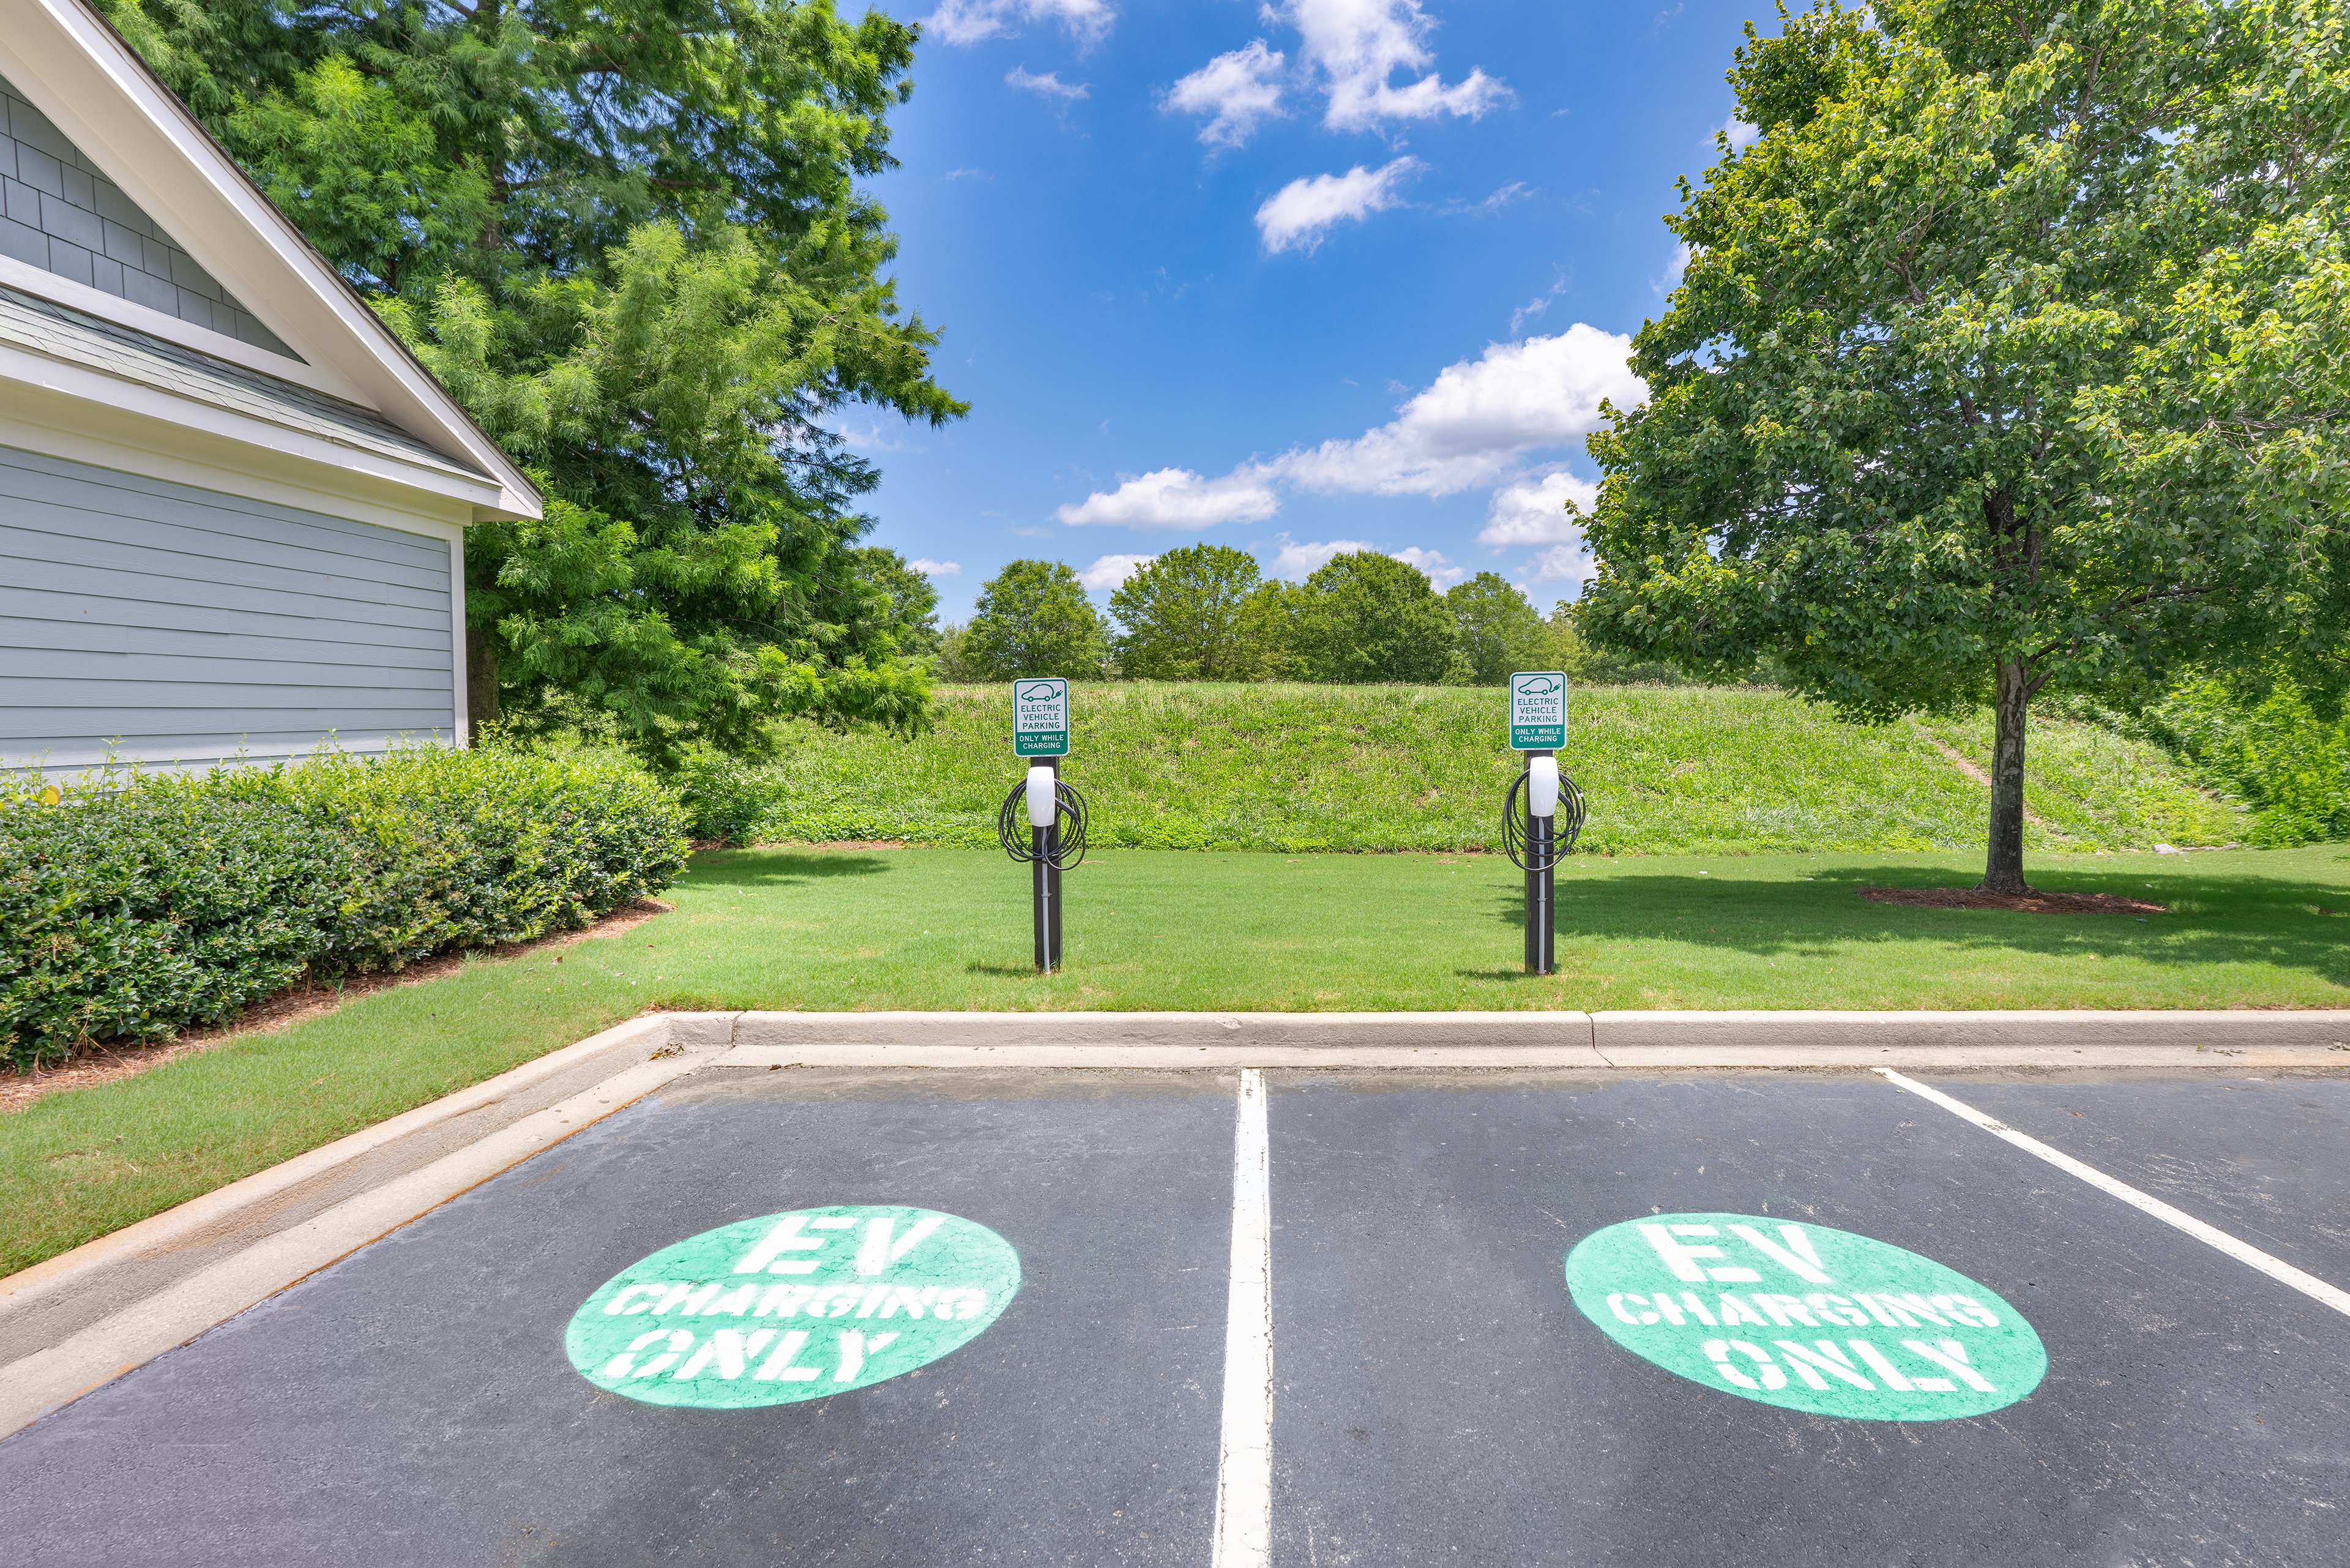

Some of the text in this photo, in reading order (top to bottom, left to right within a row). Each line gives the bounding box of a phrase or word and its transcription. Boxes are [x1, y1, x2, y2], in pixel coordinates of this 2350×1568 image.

[734, 1215, 947, 1276] EV
[1636, 1223, 1831, 1283] EV
[603, 1283, 987, 1320] CHARGING
[1605, 1293, 2001, 1327] CHARGING
[606, 1329, 901, 1382] ONLY
[1704, 1340, 1997, 1392] ONLY
